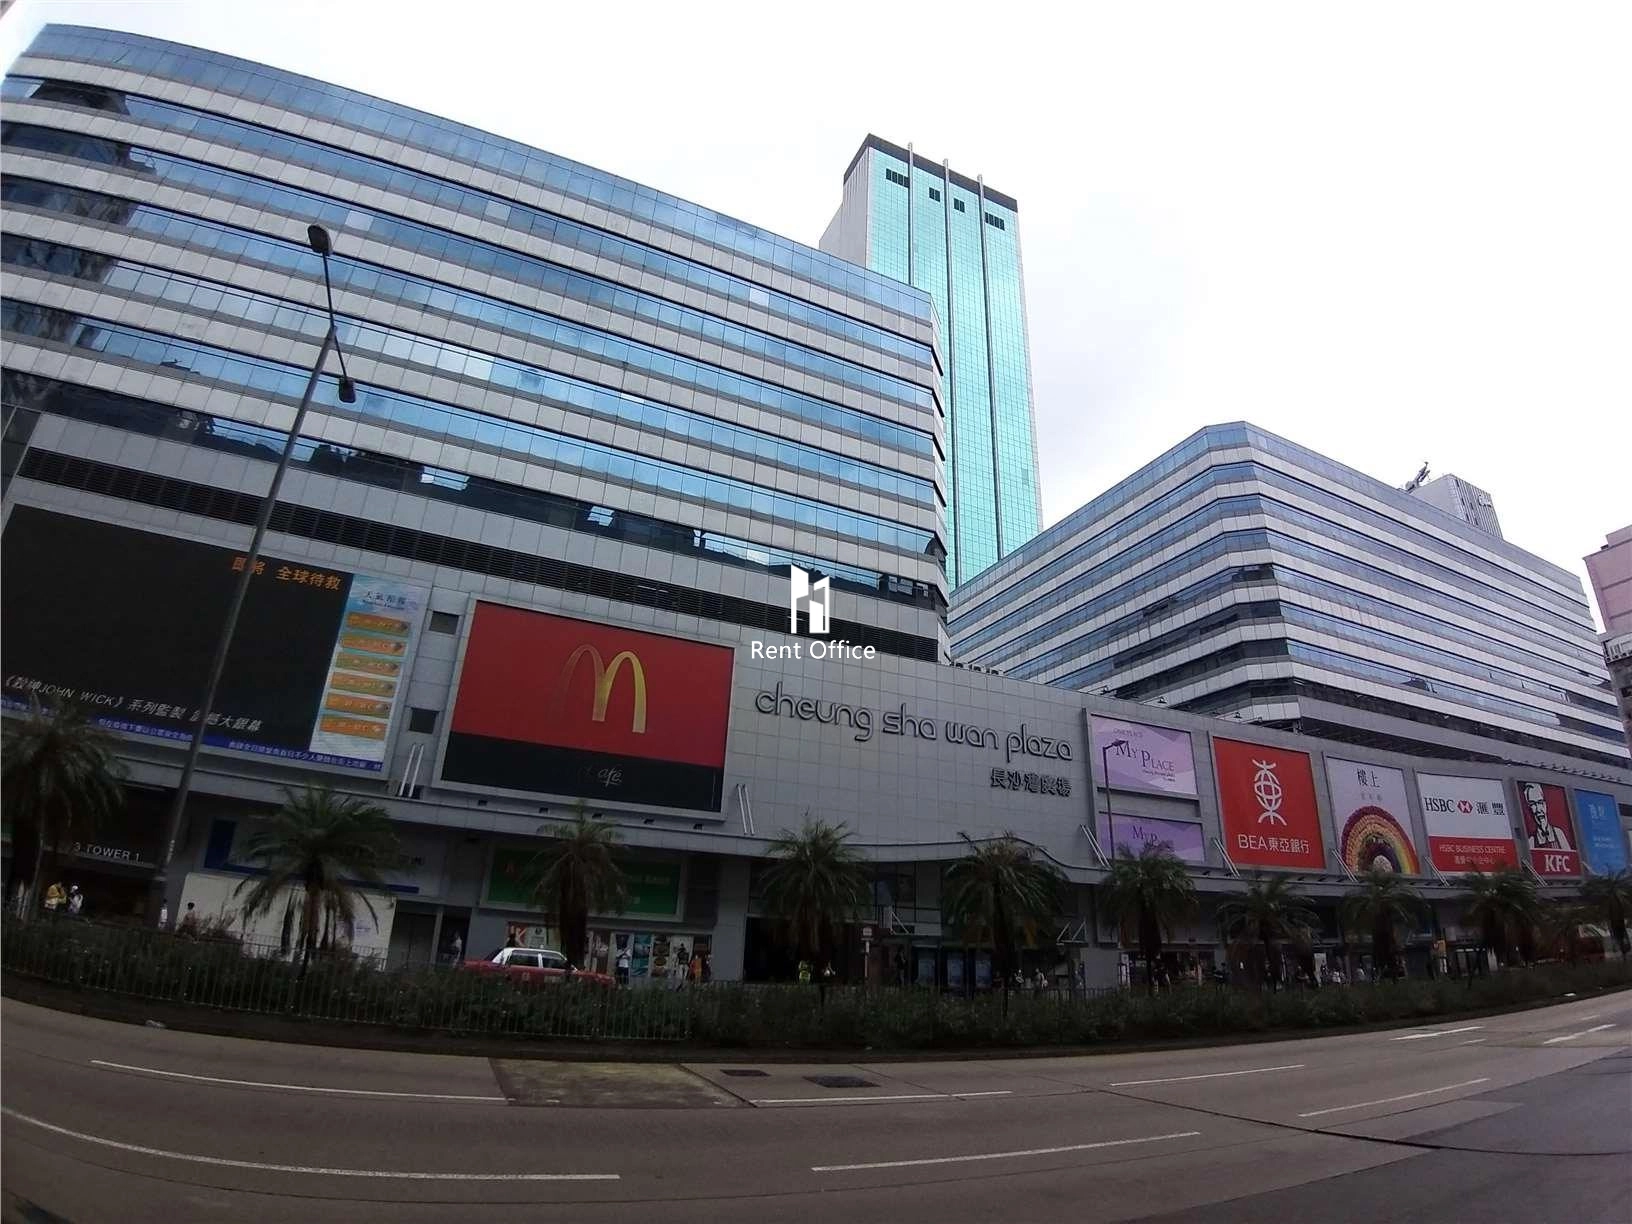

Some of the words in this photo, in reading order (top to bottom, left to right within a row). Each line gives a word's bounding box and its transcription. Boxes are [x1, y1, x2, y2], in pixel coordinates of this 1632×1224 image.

[755, 682, 873, 742] cheung
[882, 703, 937, 740] sha
[945, 720, 999, 749] wan
[1006, 723, 1073, 763] plaza
[1141, 750, 1175, 771] PLACE
[1424, 797, 1455, 813] HSBC
[87, 844, 131, 861] TOWER
[1238, 834, 1268, 851] BEA
[1268, 837, 1310, 854] 東亞銀行
[1544, 853, 1571, 873] KFC
